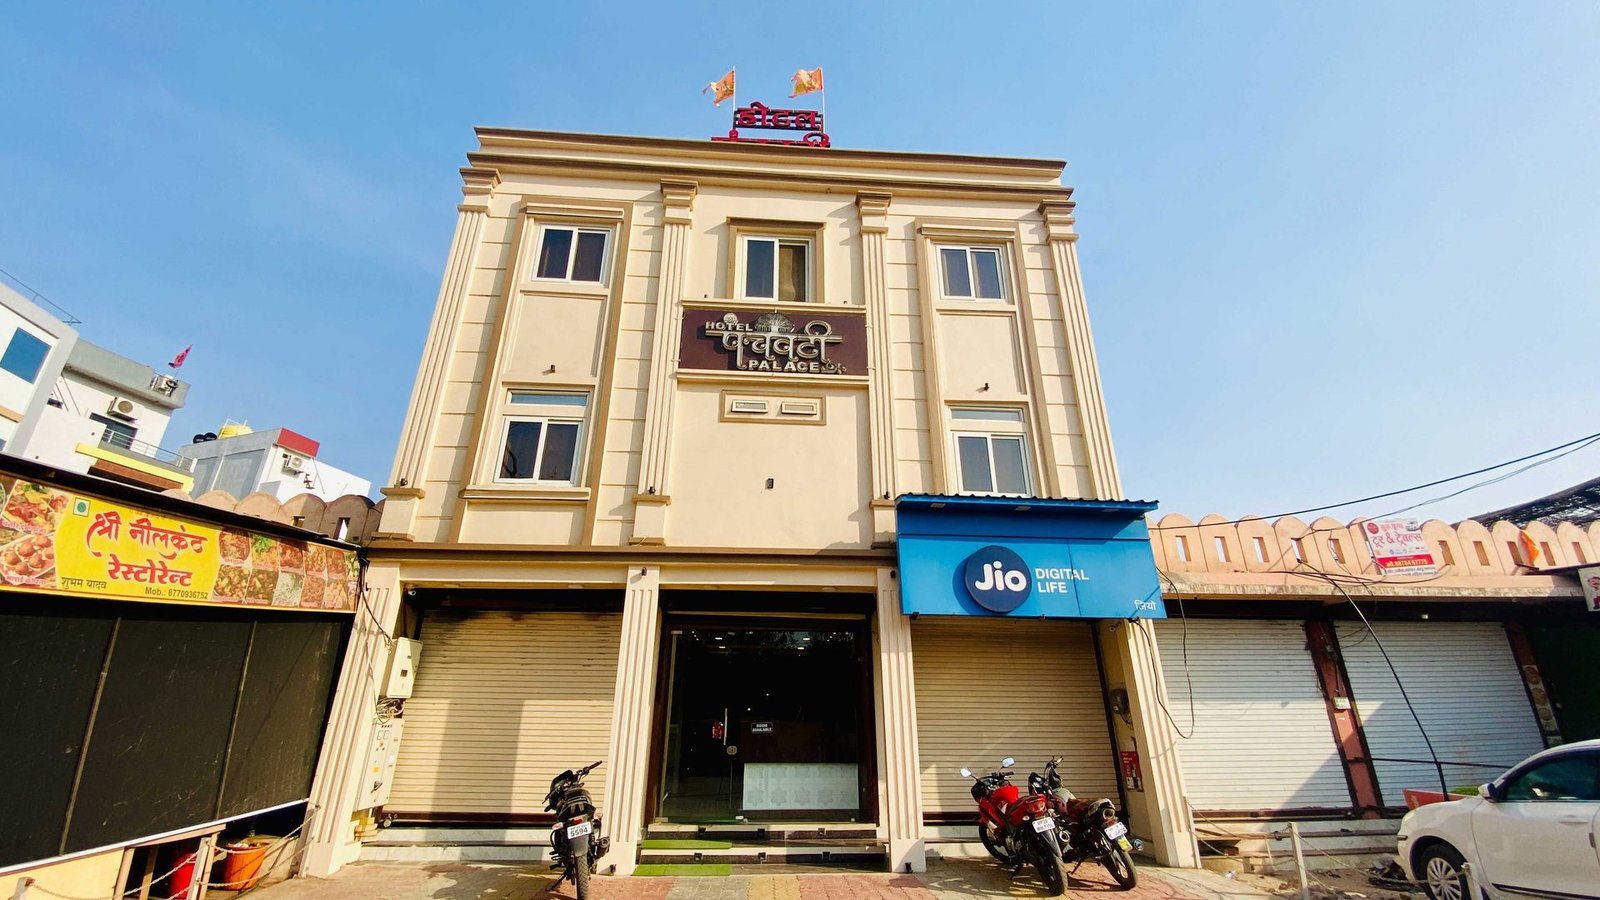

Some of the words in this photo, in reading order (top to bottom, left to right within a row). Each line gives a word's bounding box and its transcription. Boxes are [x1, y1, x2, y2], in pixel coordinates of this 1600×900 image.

[736, 101, 821, 129] होटल
[705, 321, 753, 332] HOTEL
[705, 313, 843, 369] पंचवटी
[748, 359, 820, 373] PALACE
[87, 511, 122, 557] श्री
[129, 517, 208, 560] नीलकंठ
[108, 553, 193, 587] रेस्टोरेन्ट
[975, 561, 1027, 592] Jio
[1035, 568, 1089, 580] DIGITAL
[61, 577, 83, 589] शुभम
[86, 579, 107, 590] यादव
[1037, 582, 1068, 593] LIFE
[1134, 599, 1157, 611] जियो
[571, 827, 588, 837] 5594
